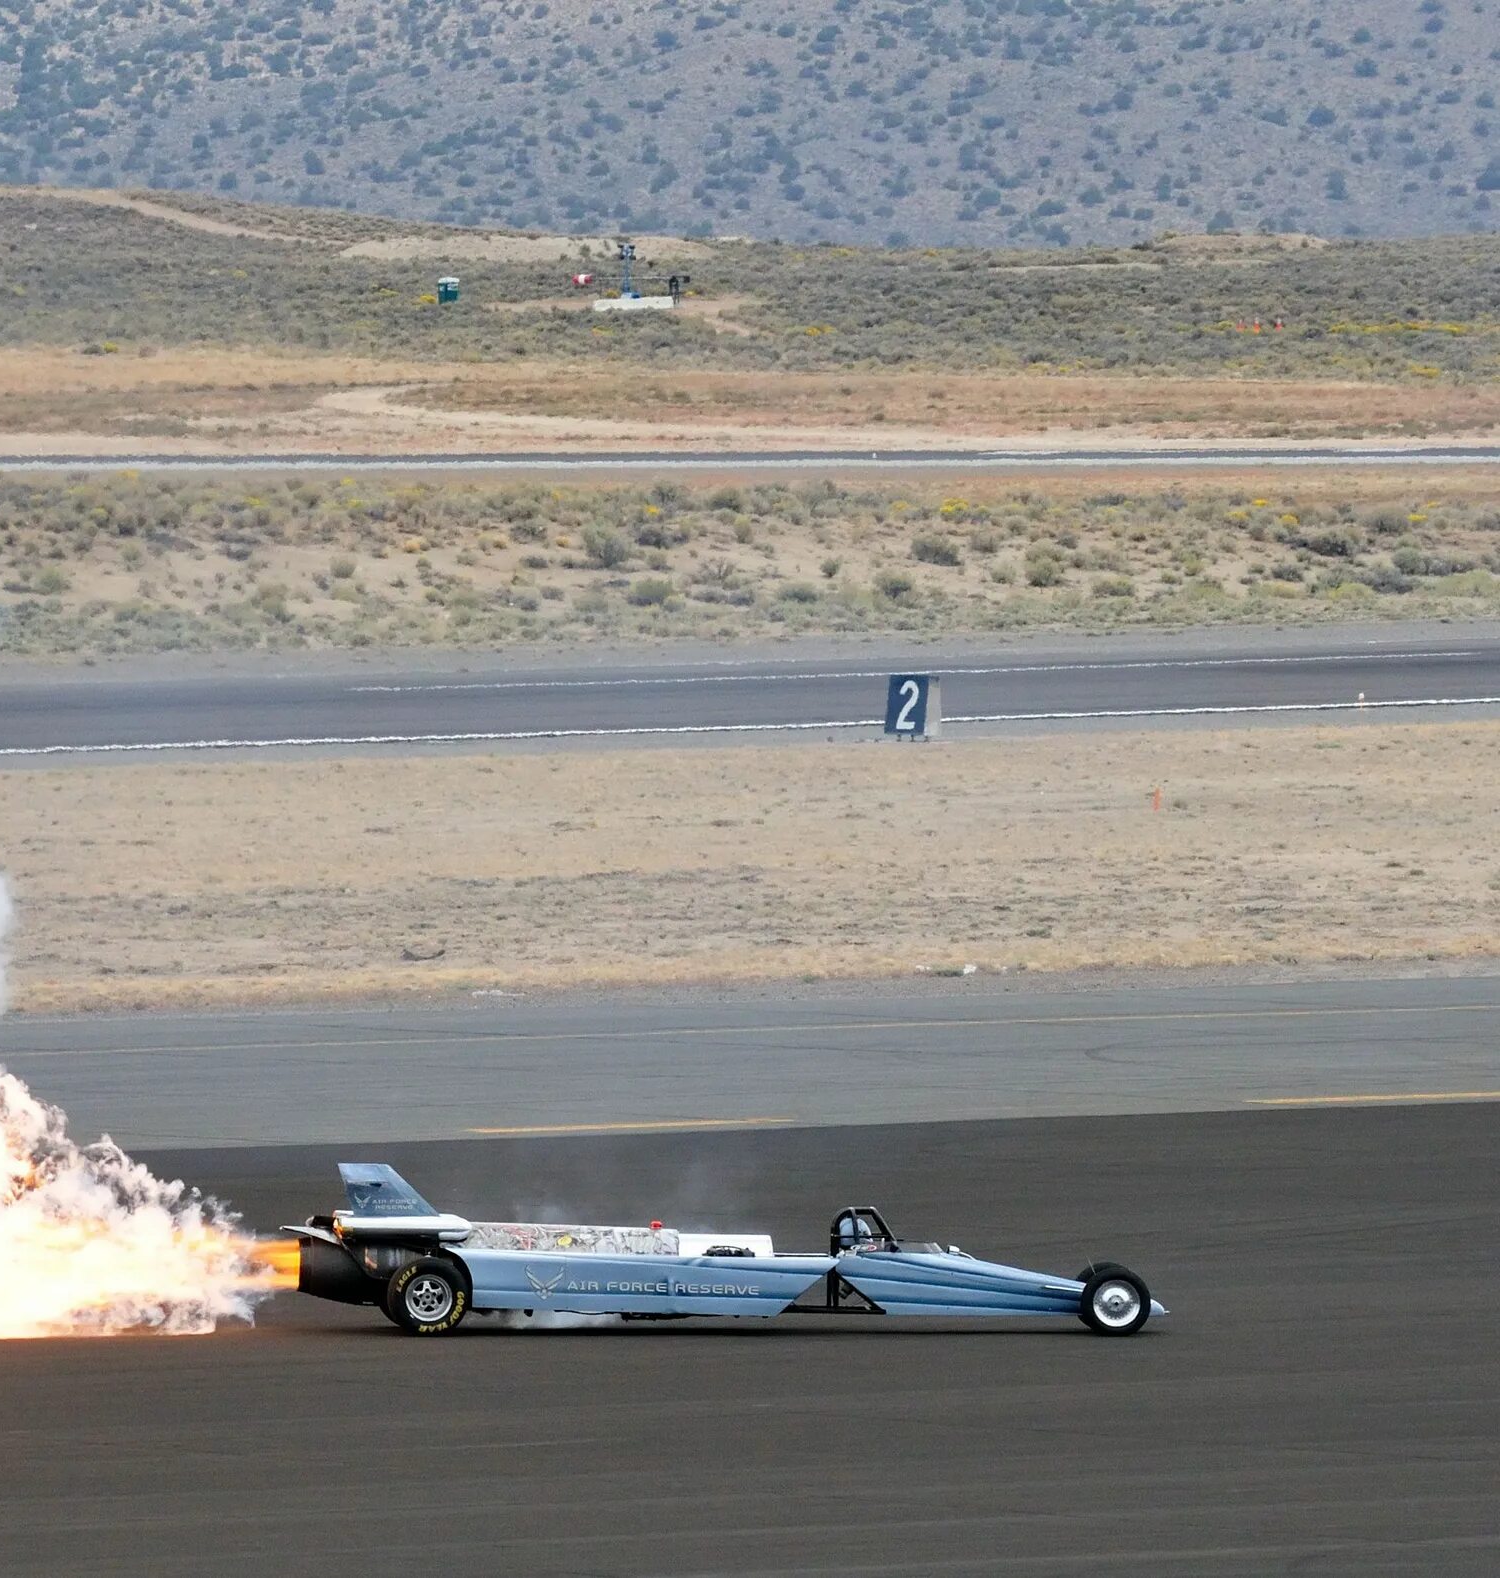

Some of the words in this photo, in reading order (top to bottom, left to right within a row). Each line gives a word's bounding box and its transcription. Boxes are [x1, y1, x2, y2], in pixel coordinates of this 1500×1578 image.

[896, 680, 919, 730] 2
[396, 1266, 418, 1293] EAGLE
[567, 1281, 599, 1291] AIR
[606, 1281, 667, 1293] FORCE
[675, 1283, 760, 1296] RESERVE
[418, 1291, 465, 1333] GOODYEAR
